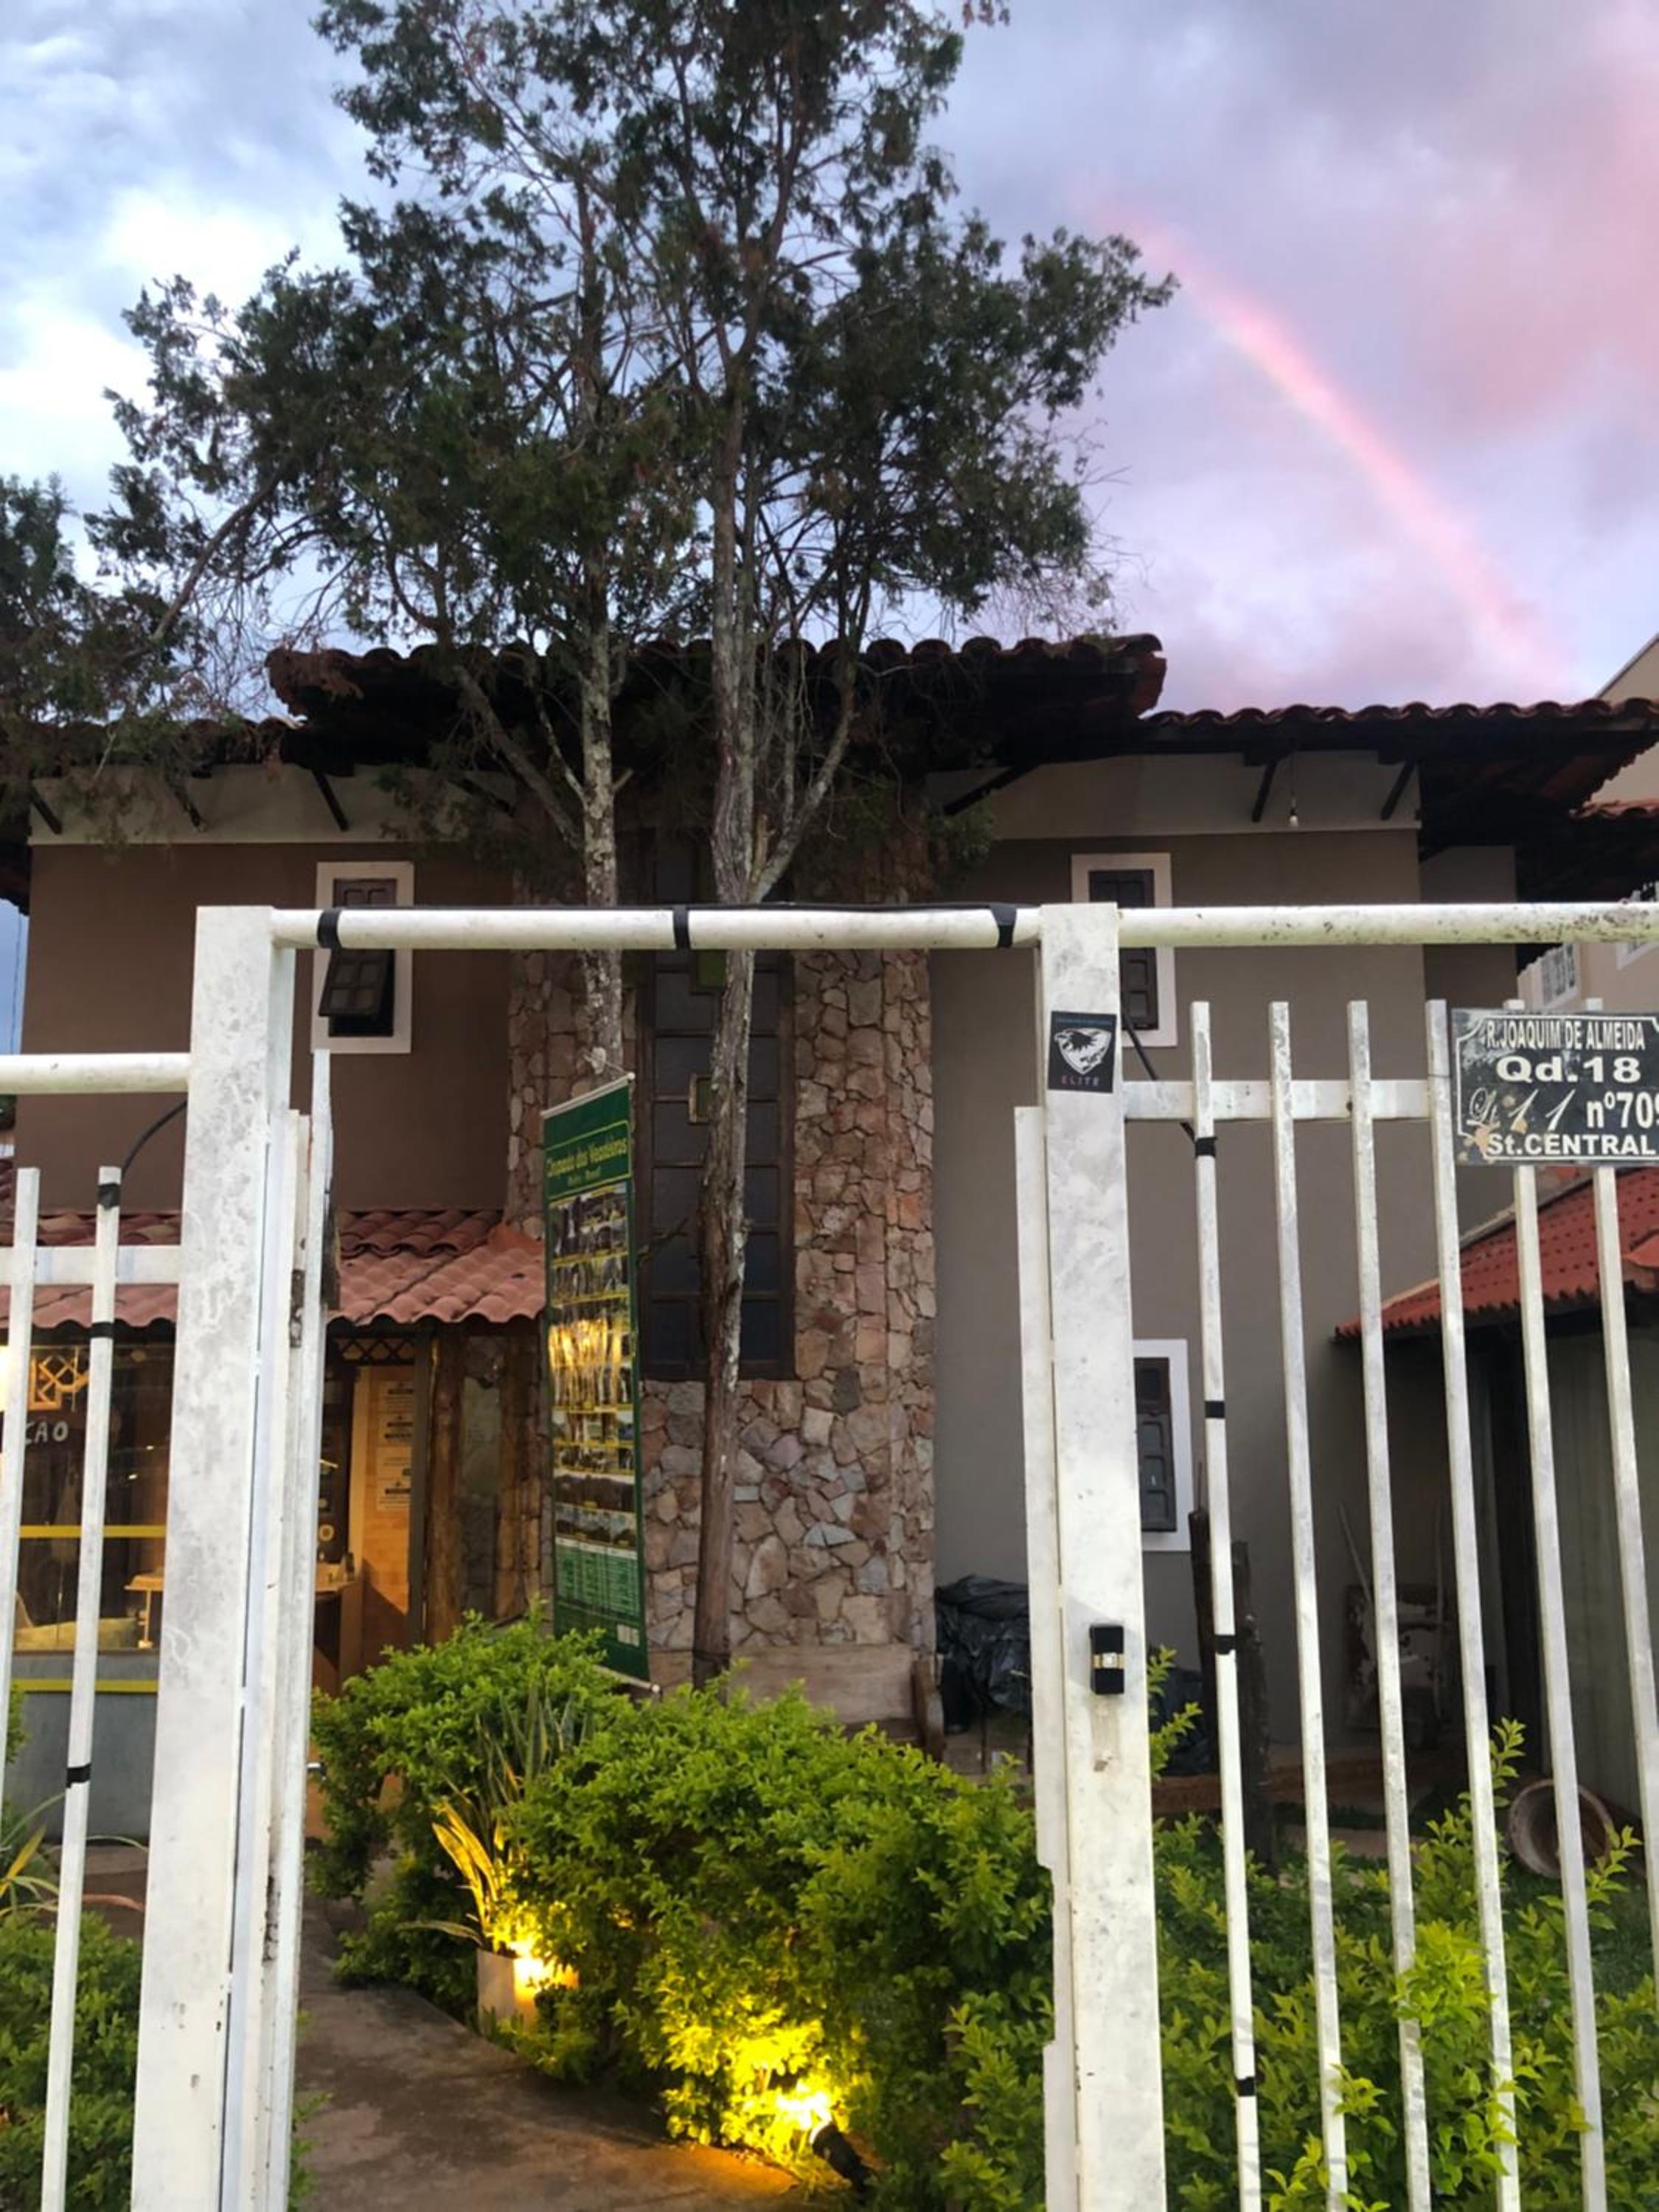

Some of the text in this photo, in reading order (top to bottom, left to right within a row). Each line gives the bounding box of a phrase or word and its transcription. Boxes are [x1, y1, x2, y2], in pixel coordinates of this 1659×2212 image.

[1486, 1020, 1645, 1050] R.JOAQUIM DE ALMEIDA
[1486, 1133, 1656, 1155] St.CENTRAL
